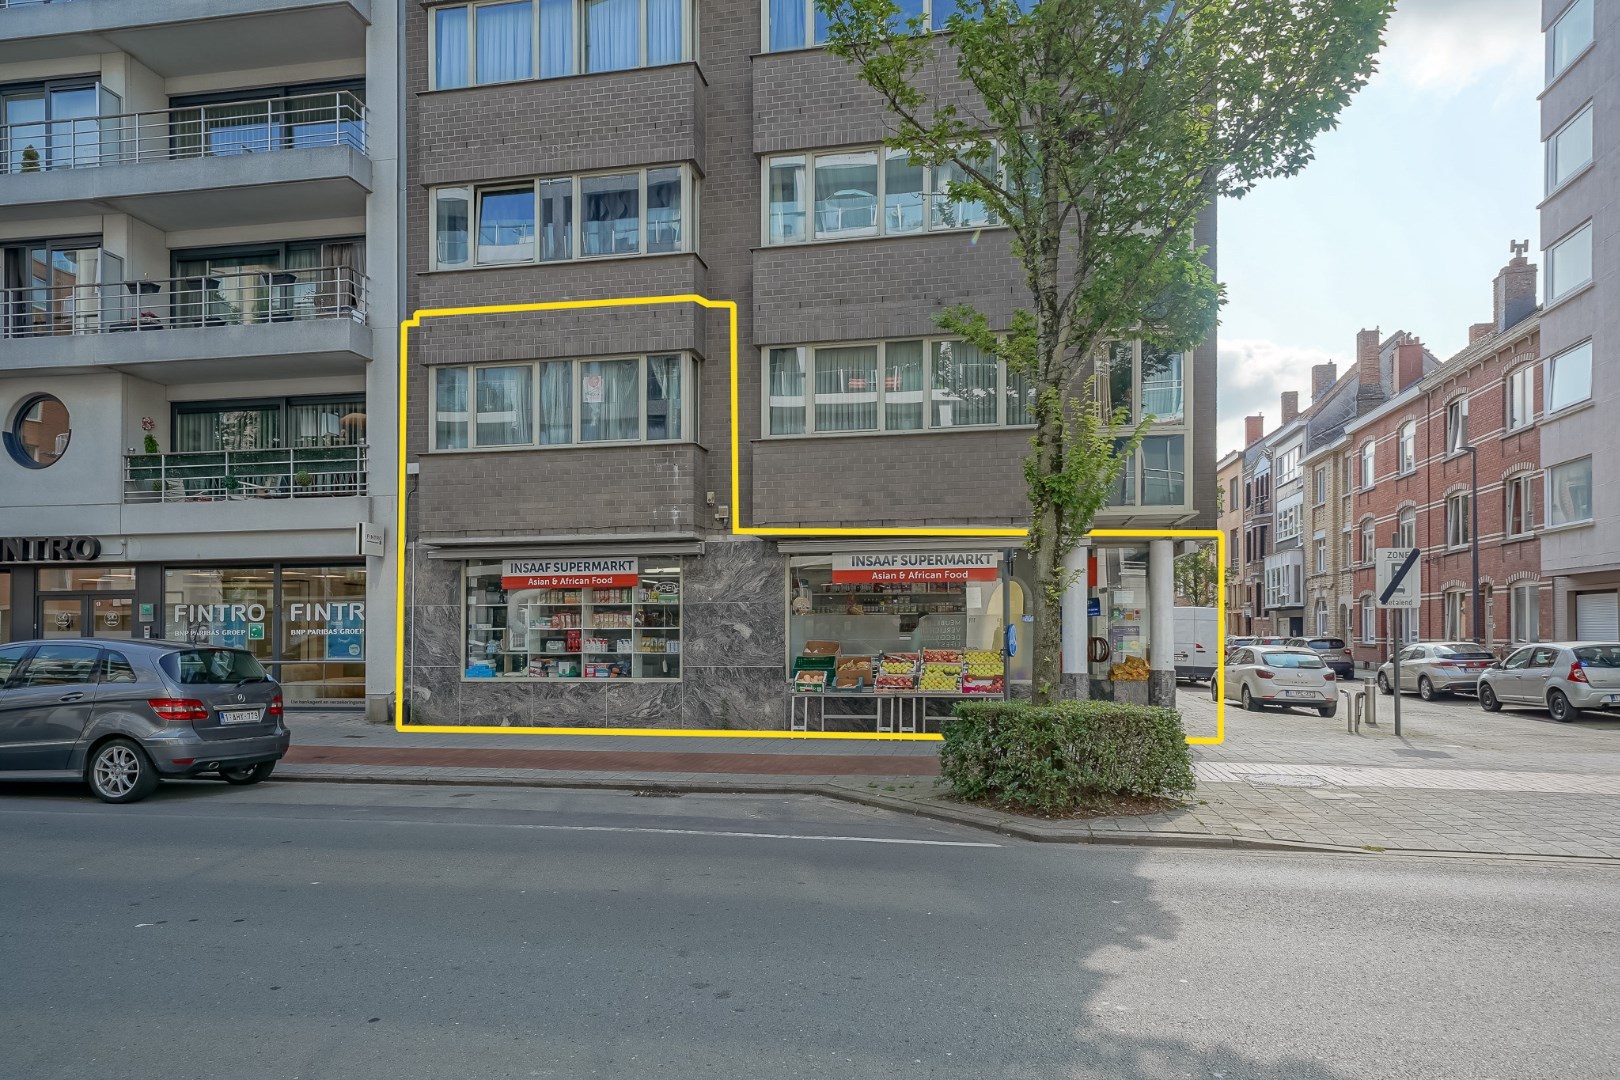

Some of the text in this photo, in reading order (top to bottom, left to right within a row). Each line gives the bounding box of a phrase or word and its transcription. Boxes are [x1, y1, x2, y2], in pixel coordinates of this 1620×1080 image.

[850, 553, 993, 567] INSAAF SUPERMARKT
[1387, 551, 1410, 559] ZONE
[510, 560, 634, 573] INSAAF SUPERMARKT
[528, 576, 613, 586] Asian & African Food
[872, 570, 969, 580] Asian & African Food
[174, 603, 266, 622] FINTRO
[290, 602, 365, 621] FINTR
